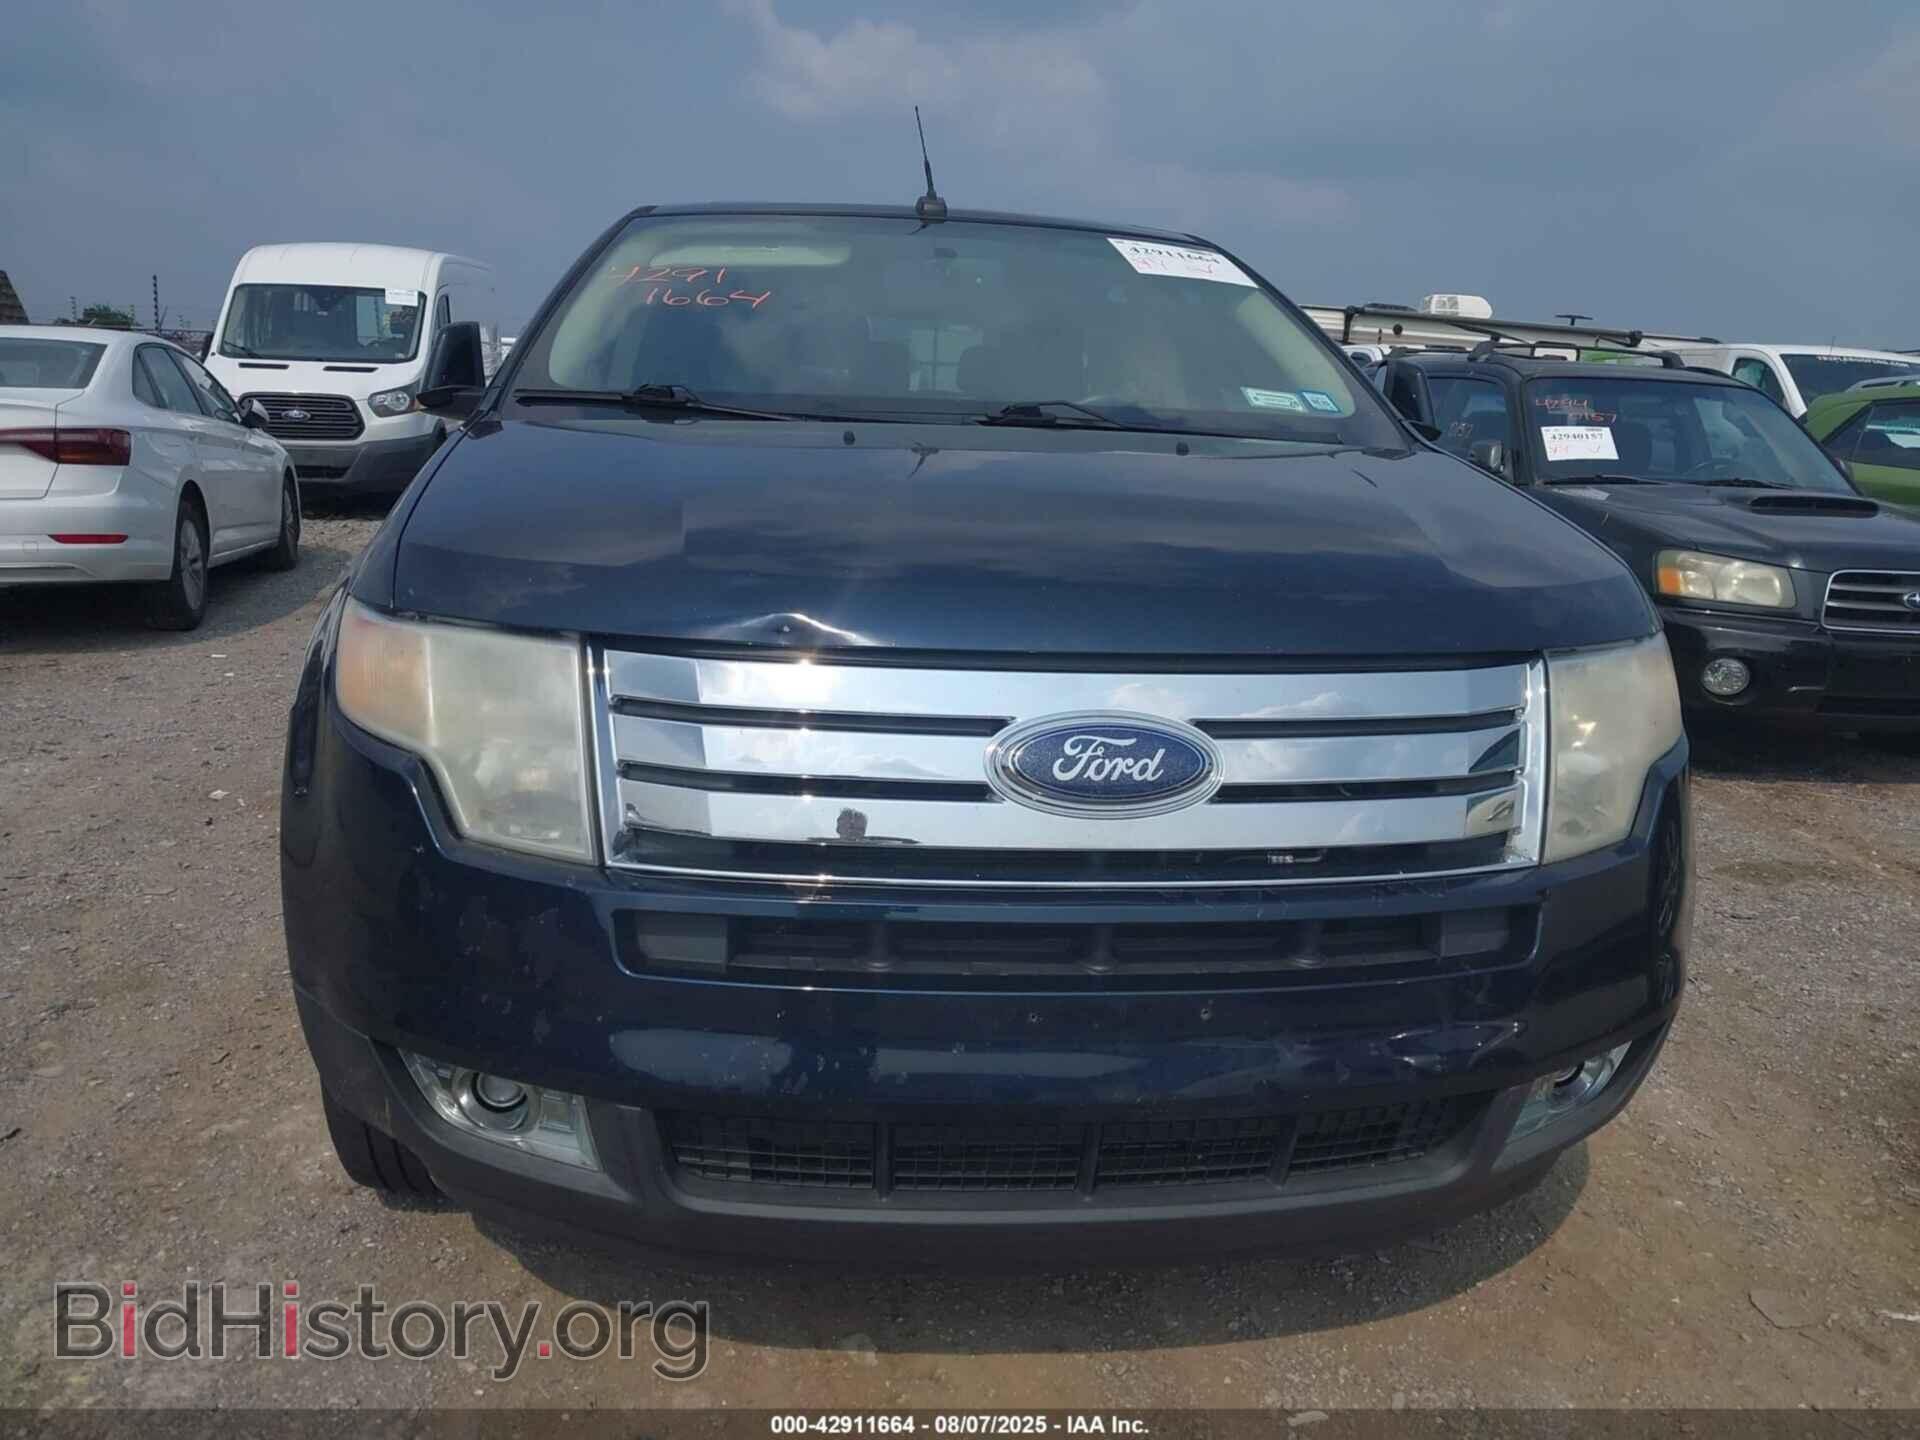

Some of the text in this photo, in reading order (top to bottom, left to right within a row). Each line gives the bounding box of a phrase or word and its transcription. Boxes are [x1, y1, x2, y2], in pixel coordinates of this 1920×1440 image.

[644, 287, 772, 309] 1664
[1550, 432, 1604, 441] 42940157
[1052, 735, 1166, 782] Ford
